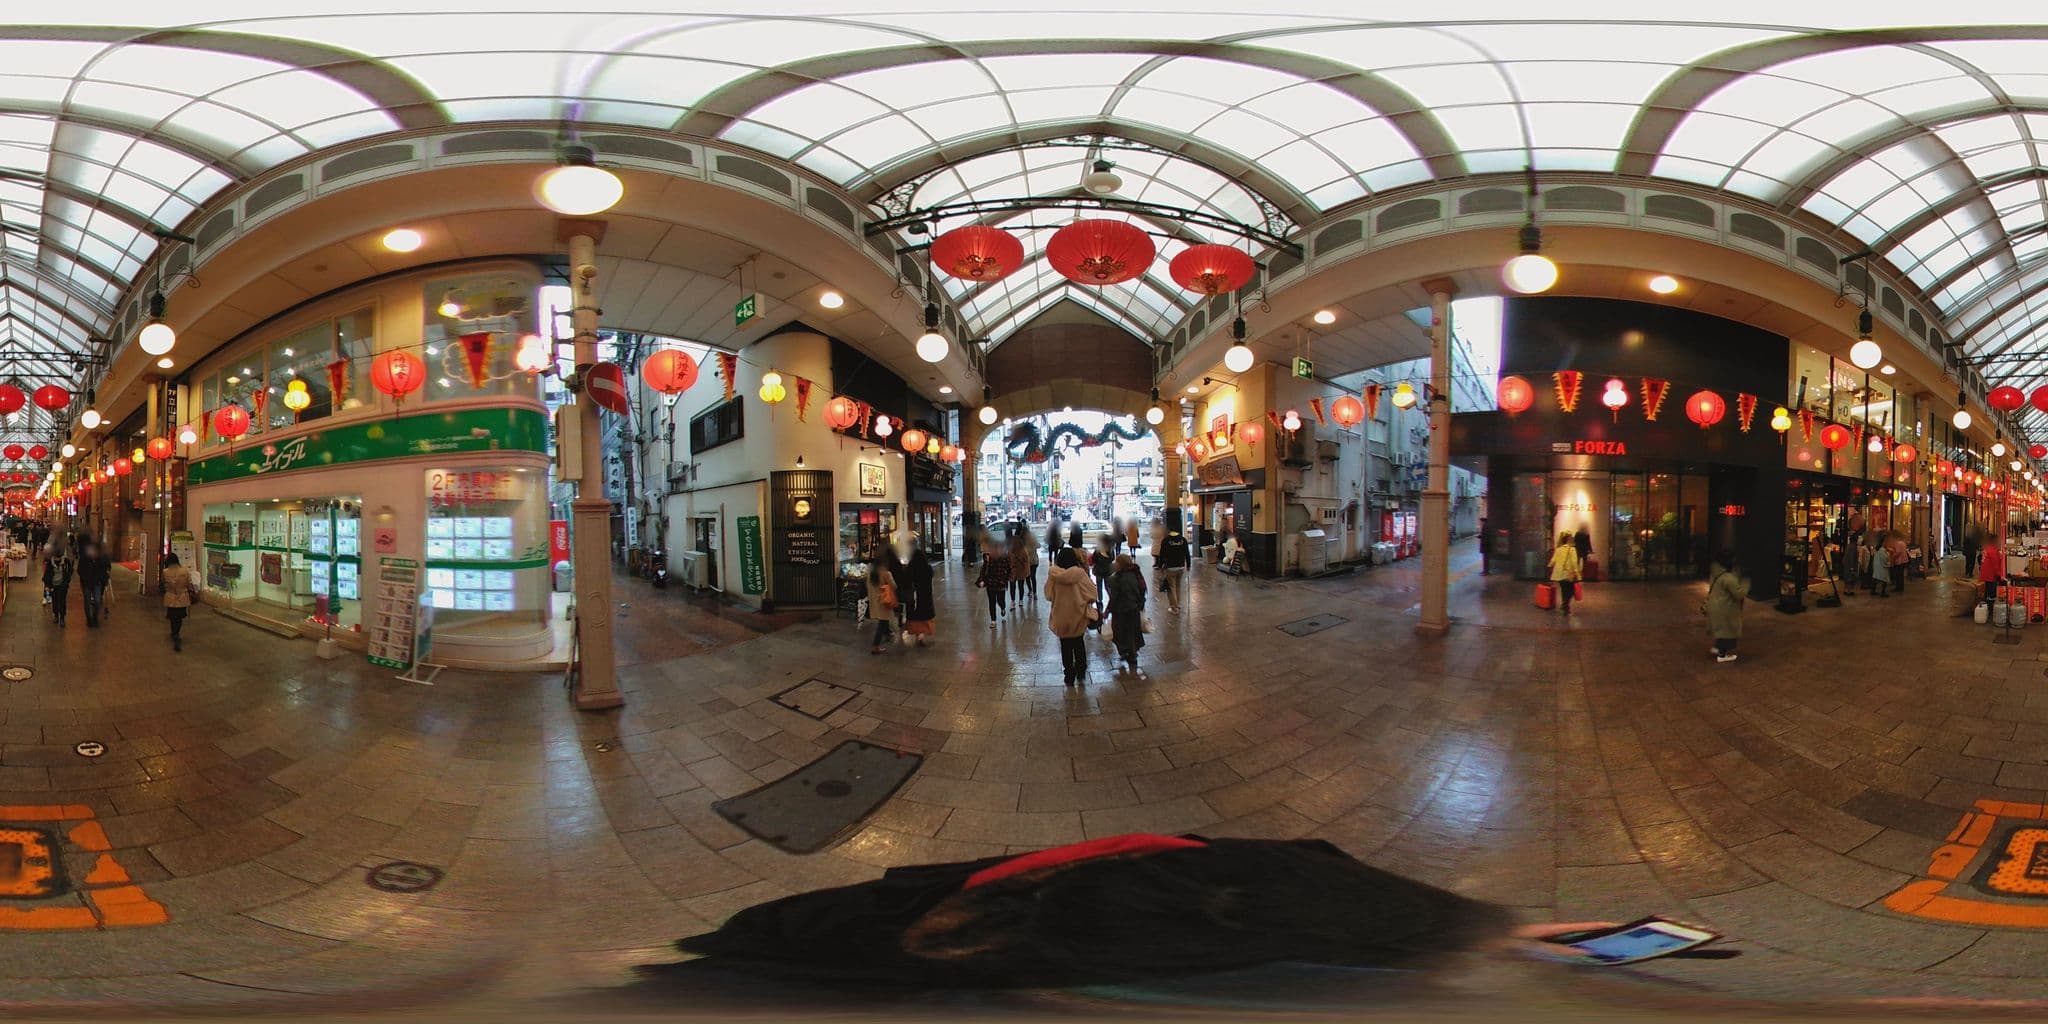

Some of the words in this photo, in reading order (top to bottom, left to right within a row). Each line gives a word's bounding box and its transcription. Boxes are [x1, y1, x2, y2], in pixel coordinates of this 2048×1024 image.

[256, 436, 308, 474] エイブル
[1574, 440, 1627, 455] FORZA
[1725, 504, 1745, 516] FORZA
